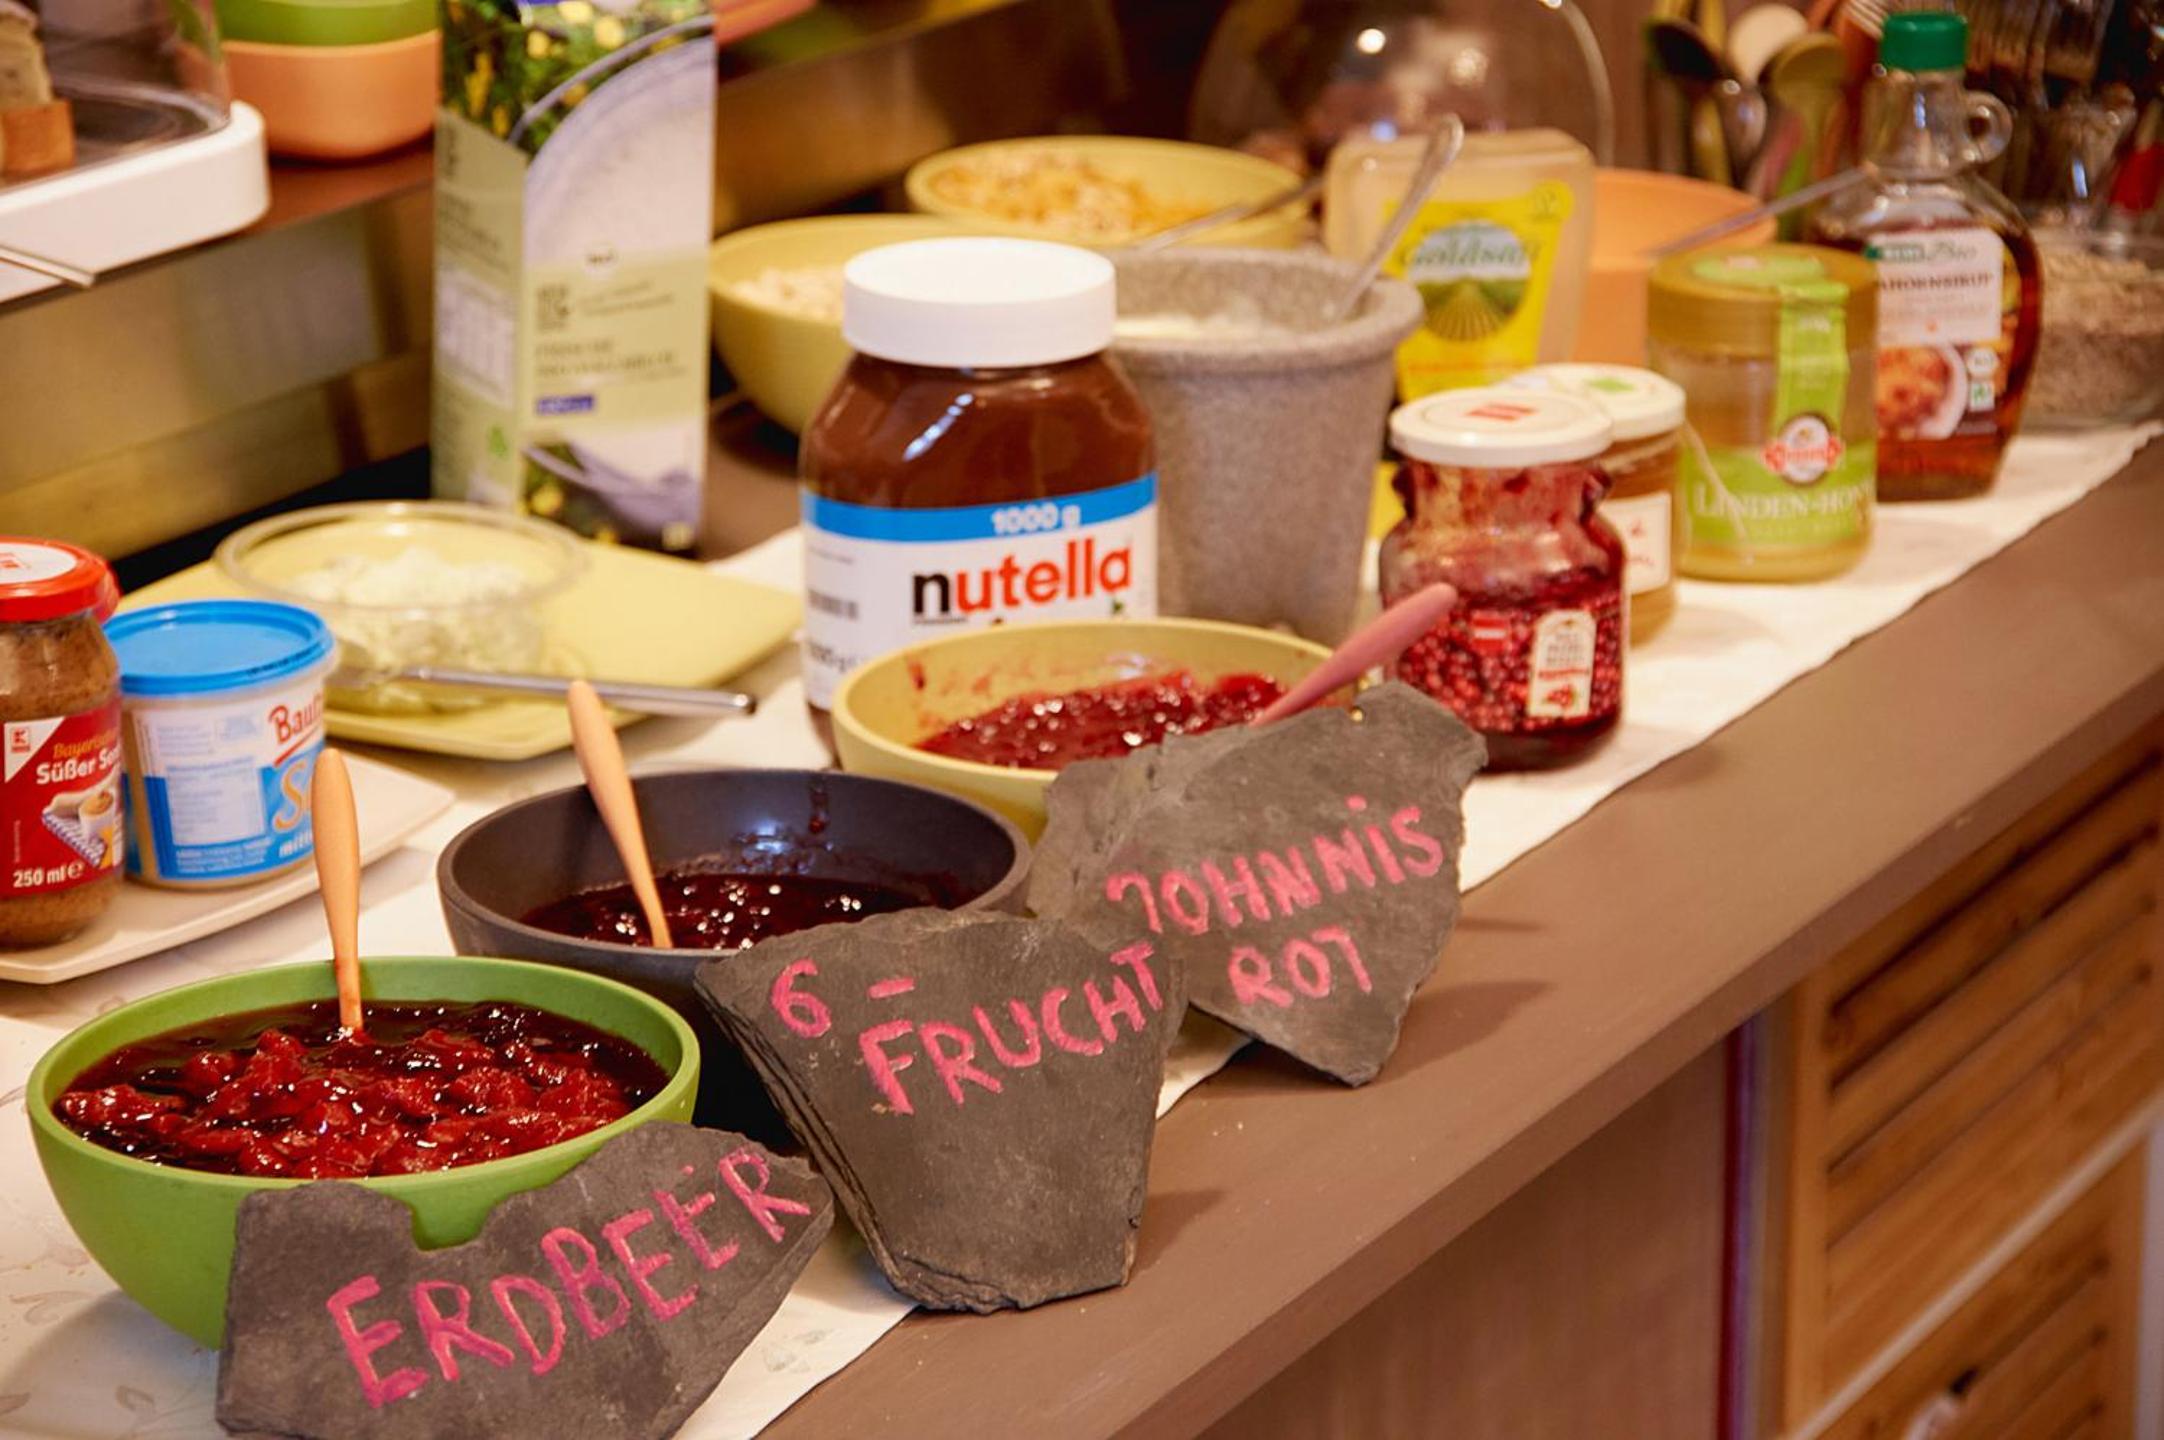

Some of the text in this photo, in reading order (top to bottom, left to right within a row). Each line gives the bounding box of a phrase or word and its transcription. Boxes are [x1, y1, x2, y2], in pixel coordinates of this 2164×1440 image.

[911, 536, 1132, 616] nutella
[36, 756, 98, 785] Süßer
[13, 868, 43, 888] 250
[47, 864, 65, 884] ml
[1229, 924, 1373, 1008] ROT
[858, 941, 1163, 1115] FRUCHT
[326, 1146, 812, 1409] ERDBEER
